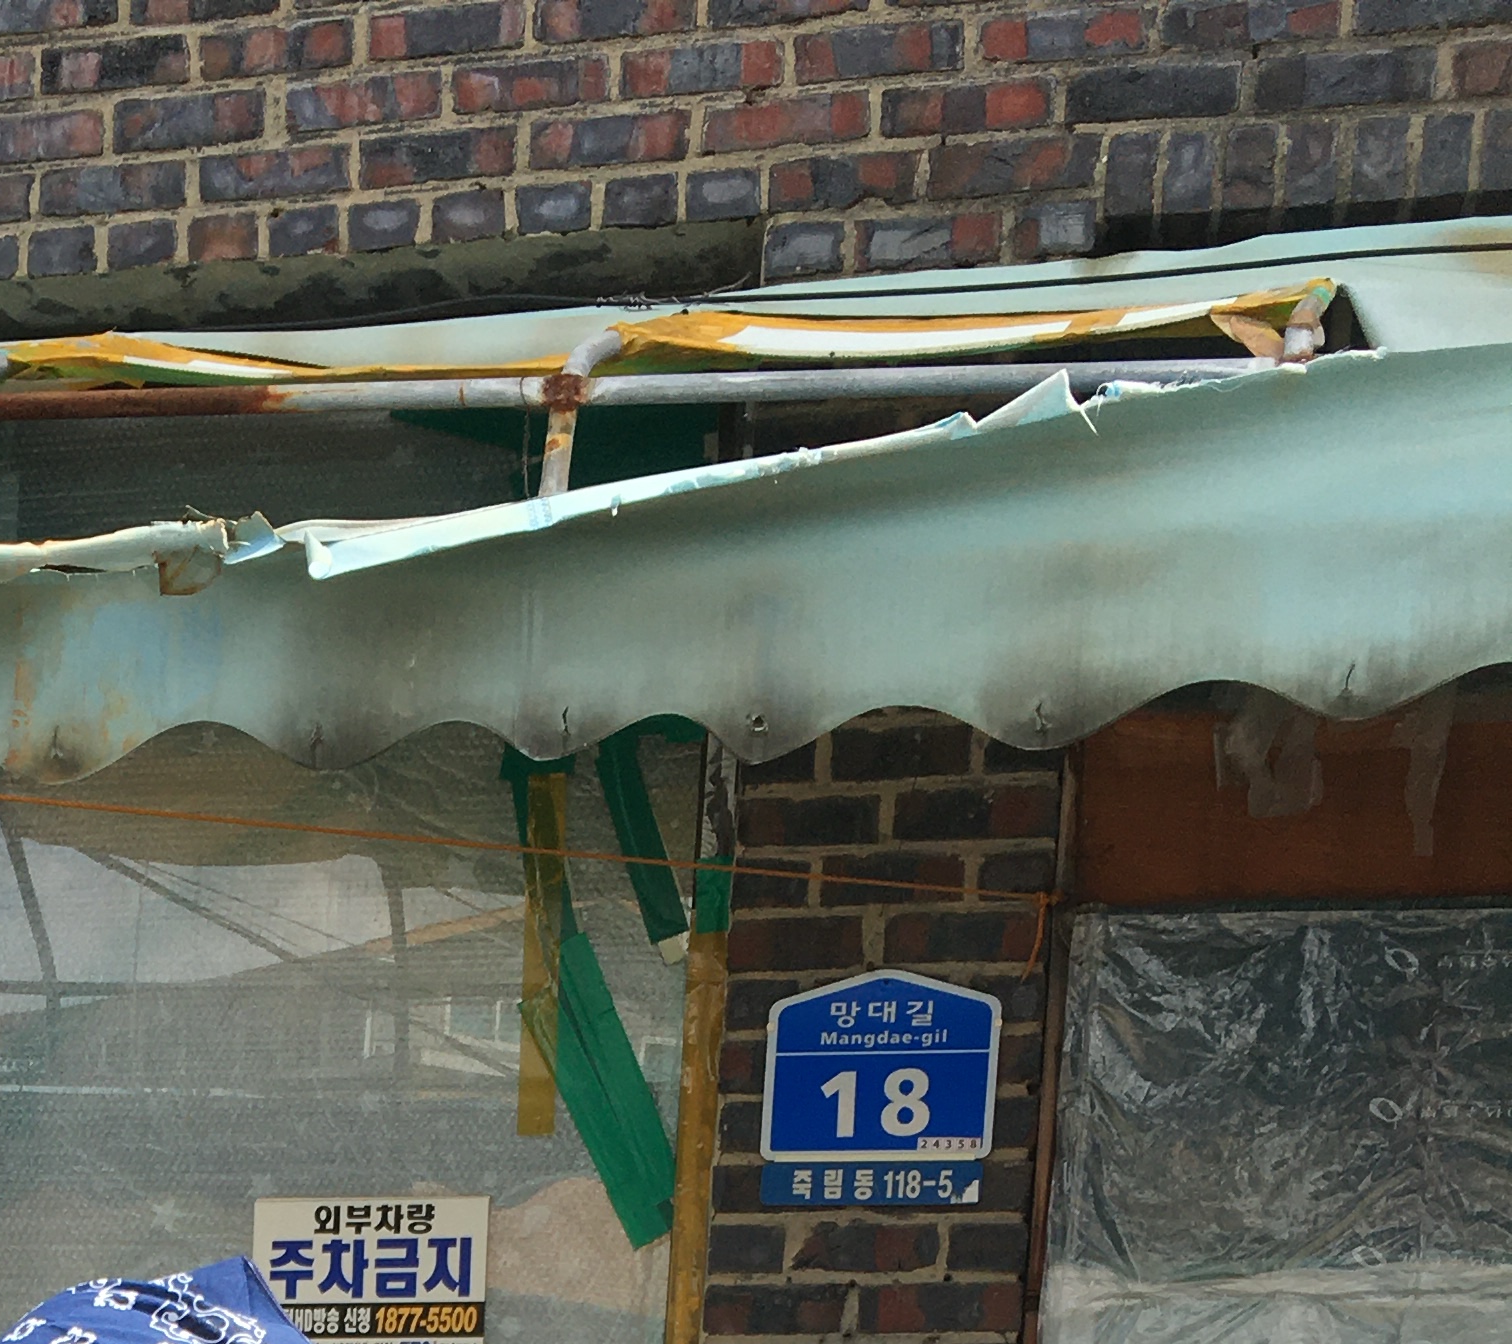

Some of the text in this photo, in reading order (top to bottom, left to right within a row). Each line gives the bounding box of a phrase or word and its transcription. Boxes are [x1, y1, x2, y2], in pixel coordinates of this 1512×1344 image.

[830, 1000, 934, 1029] 망대길
[820, 1029, 948, 1049] Mangdae-gil
[820, 1067, 931, 1138] 18
[920, 1139, 977, 1149] 24358
[791, 1168, 953, 1201] 죽림동 118-5
[314, 1204, 436, 1235] 외부차량
[269, 1236, 473, 1300] 주차금지
[343, 1307, 371, 1334] 신청
[374, 1306, 478, 1335] 1877-5500
